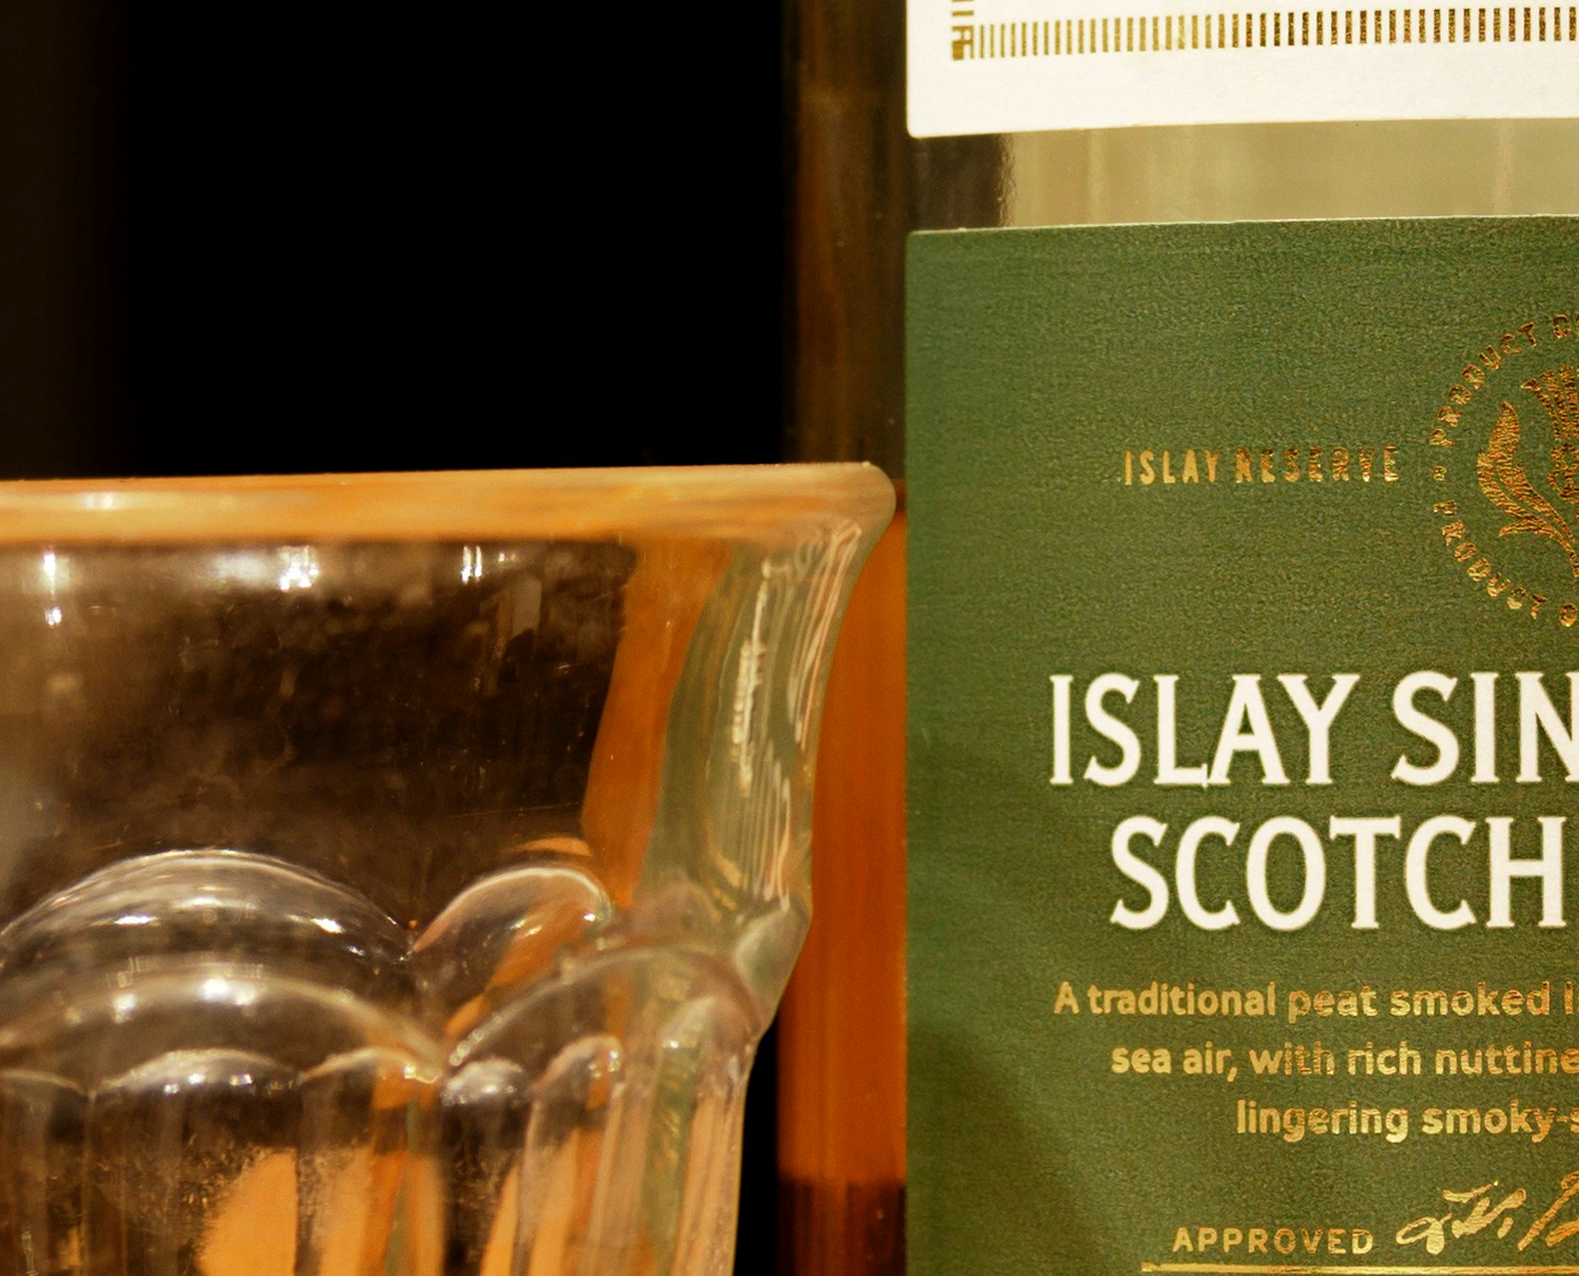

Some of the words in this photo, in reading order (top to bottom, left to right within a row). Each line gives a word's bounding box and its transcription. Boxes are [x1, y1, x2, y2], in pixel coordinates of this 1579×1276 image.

[1429, 321, 1537, 447] PRODUCT
[1124, 448, 1219, 485] ISLAY
[1235, 443, 1400, 484] RESERVE
[1048, 671, 1355, 789] ISLAY
[1109, 813, 1567, 932] SCOTCH
[1053, 980, 1080, 1015] A
[1087, 980, 1277, 1017] traditional
[1288, 985, 1379, 1025] peat
[1390, 980, 1551, 1017] smoked
[1111, 1045, 1173, 1075] sea
[1182, 1040, 1238, 1083] air,
[1249, 1041, 1336, 1076] with
[1347, 1041, 1423, 1076] rich
[1236, 1098, 1410, 1144] lingering
[1172, 1226, 1374, 1255] APPROVED
